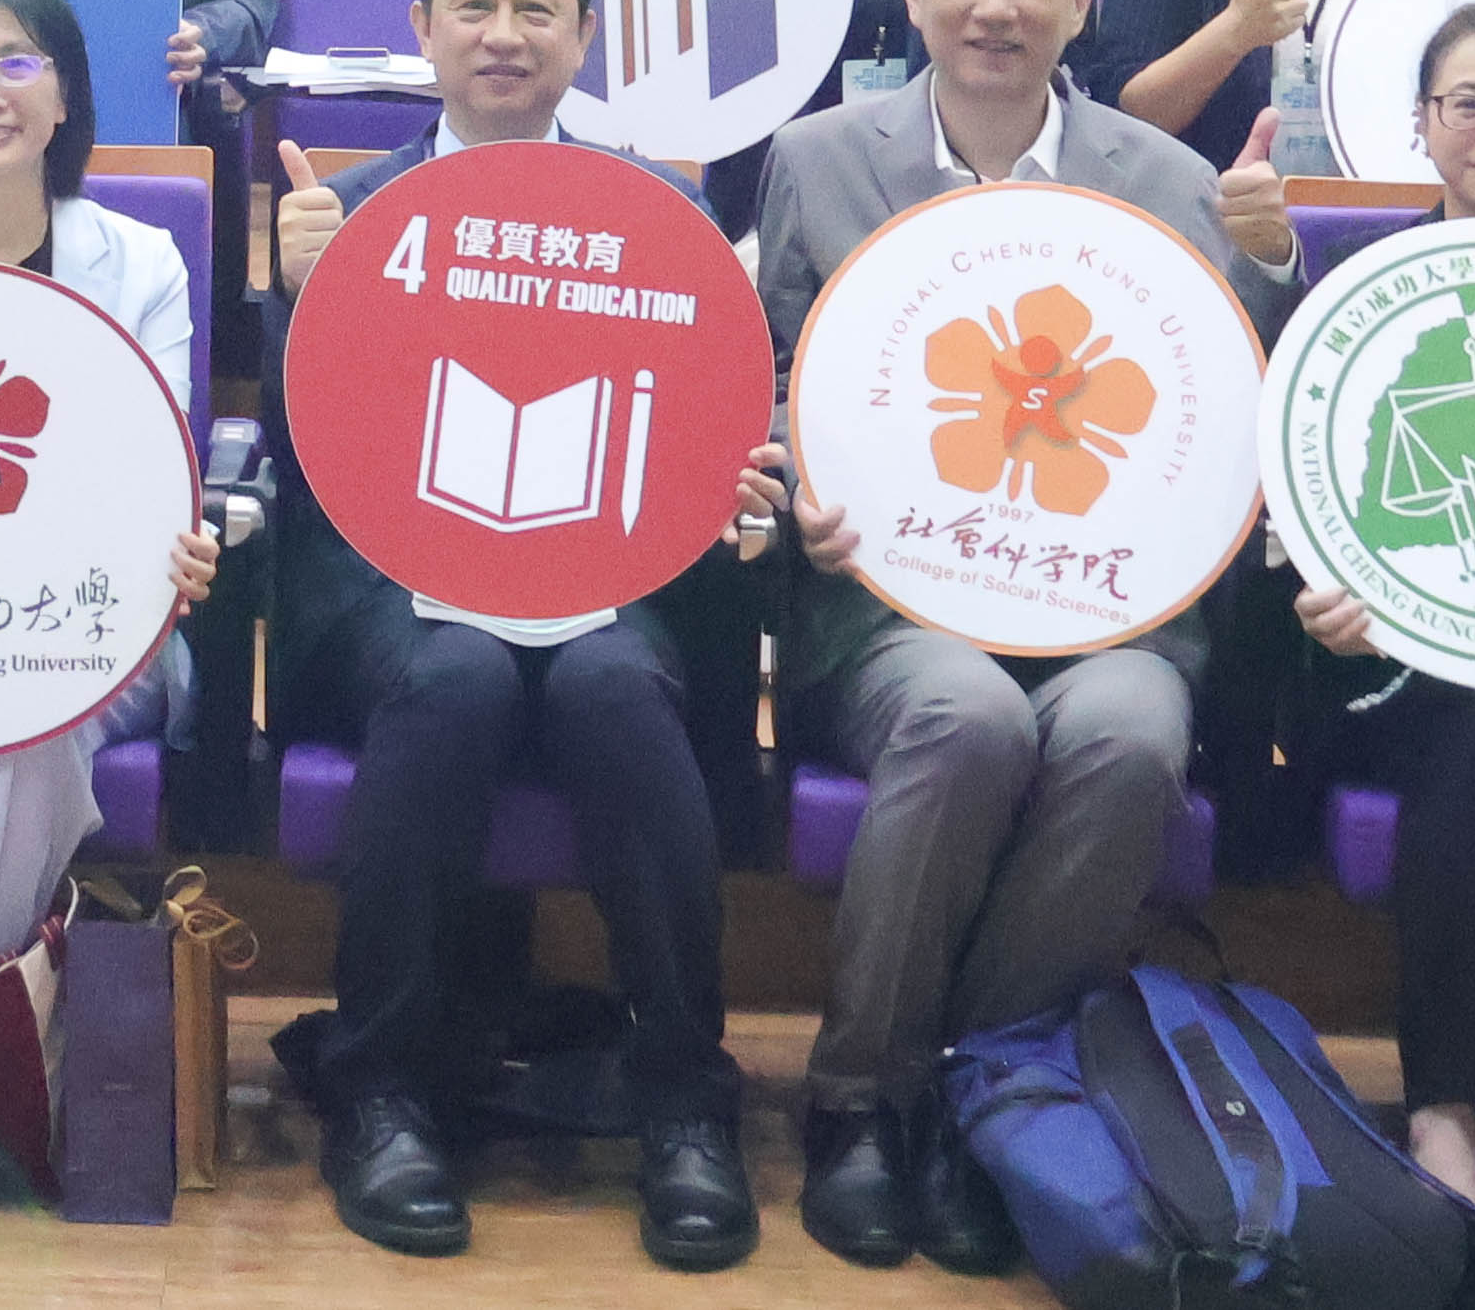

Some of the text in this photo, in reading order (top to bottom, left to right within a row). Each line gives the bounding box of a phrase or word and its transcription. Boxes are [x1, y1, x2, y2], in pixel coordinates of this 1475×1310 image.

[382, 214, 431, 294] 4
[453, 214, 626, 274] 優質教育
[446, 266, 697, 326] QUALITY EDUCATION
[987, 502, 1035, 525] 1997
[1299, 422, 1341, 547] NATIONAL
[1339, 542, 1407, 619] CHENG
[882, 547, 1133, 627] College of Social Sciences
[11, 653, 118, 677] University
